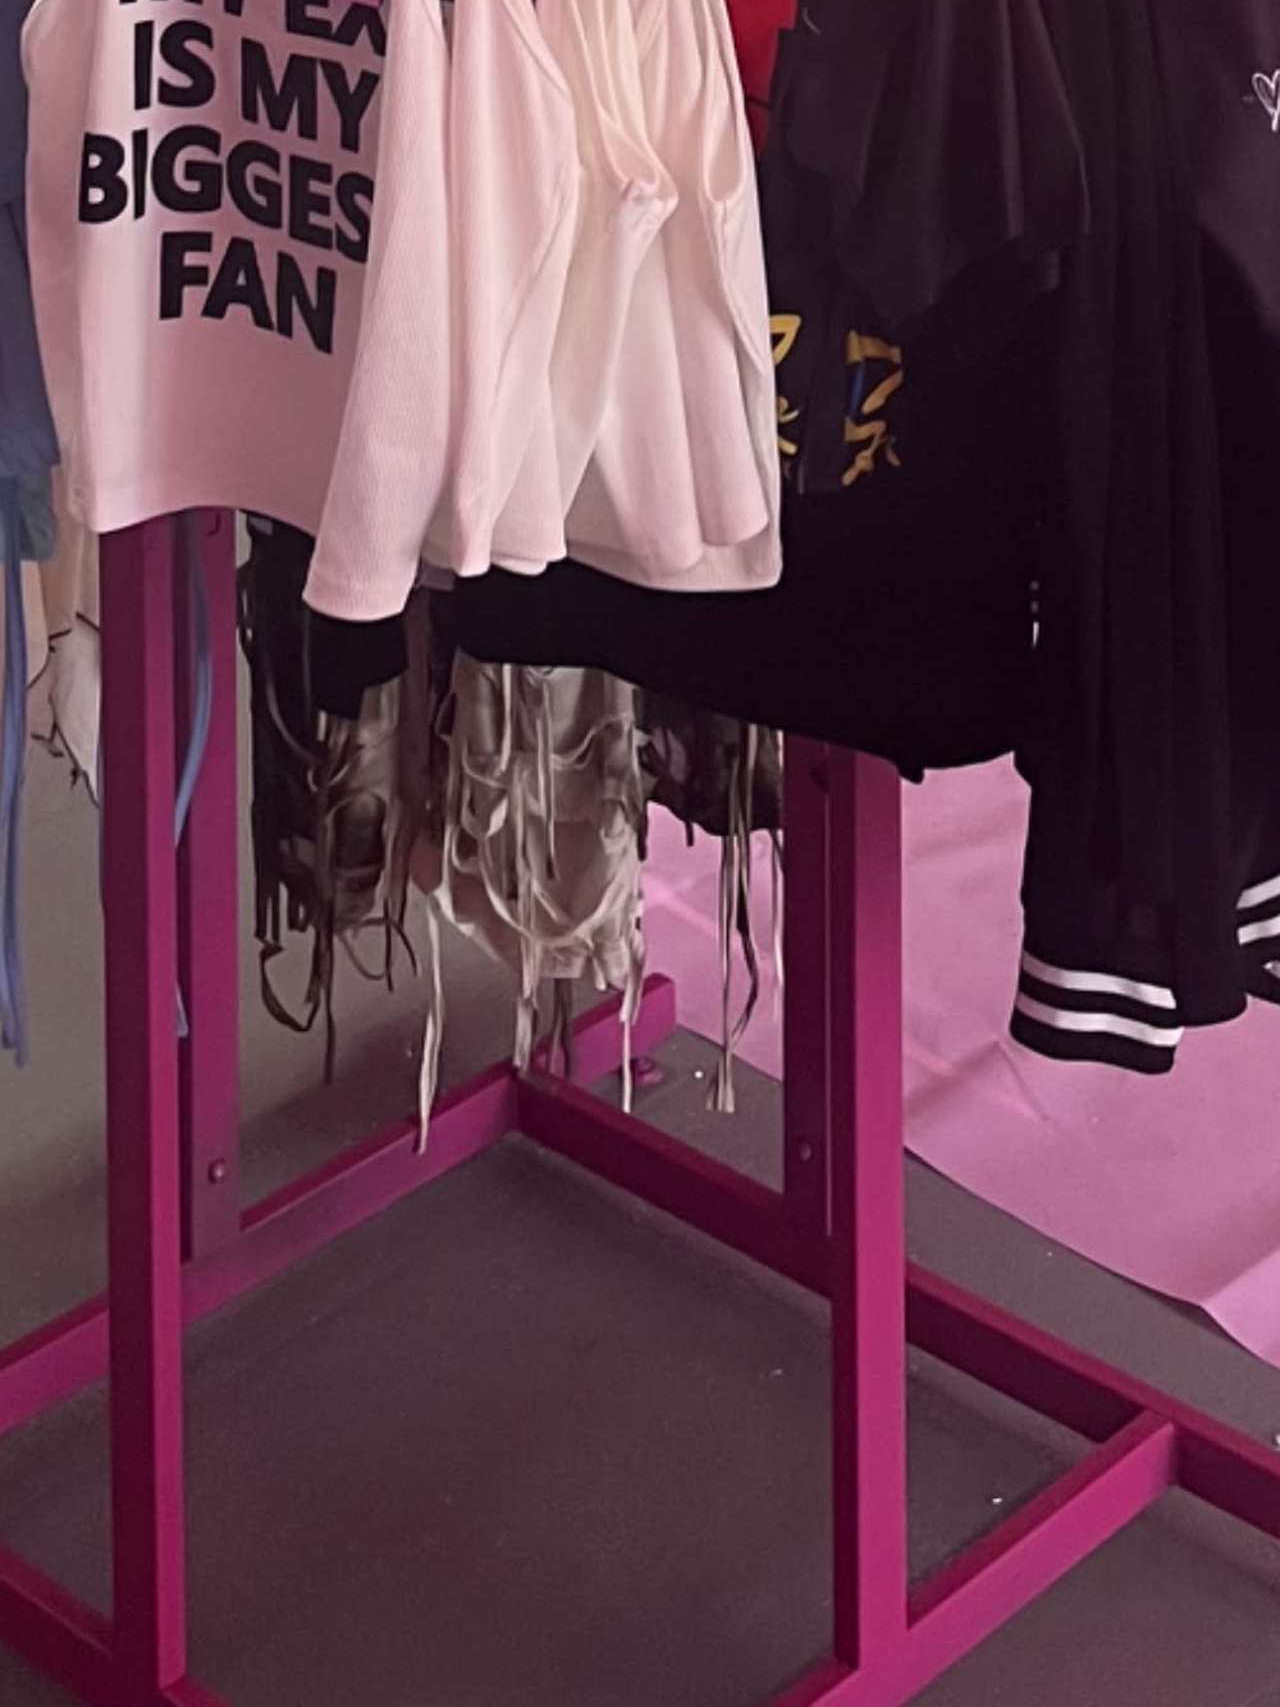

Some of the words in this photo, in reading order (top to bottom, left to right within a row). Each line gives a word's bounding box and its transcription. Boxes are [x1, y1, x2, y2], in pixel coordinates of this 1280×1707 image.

[133, 19, 216, 111] IS
[240, 37, 381, 153] MY
[77, 124, 374, 264] BIGGES
[158, 230, 337, 356] FAN
